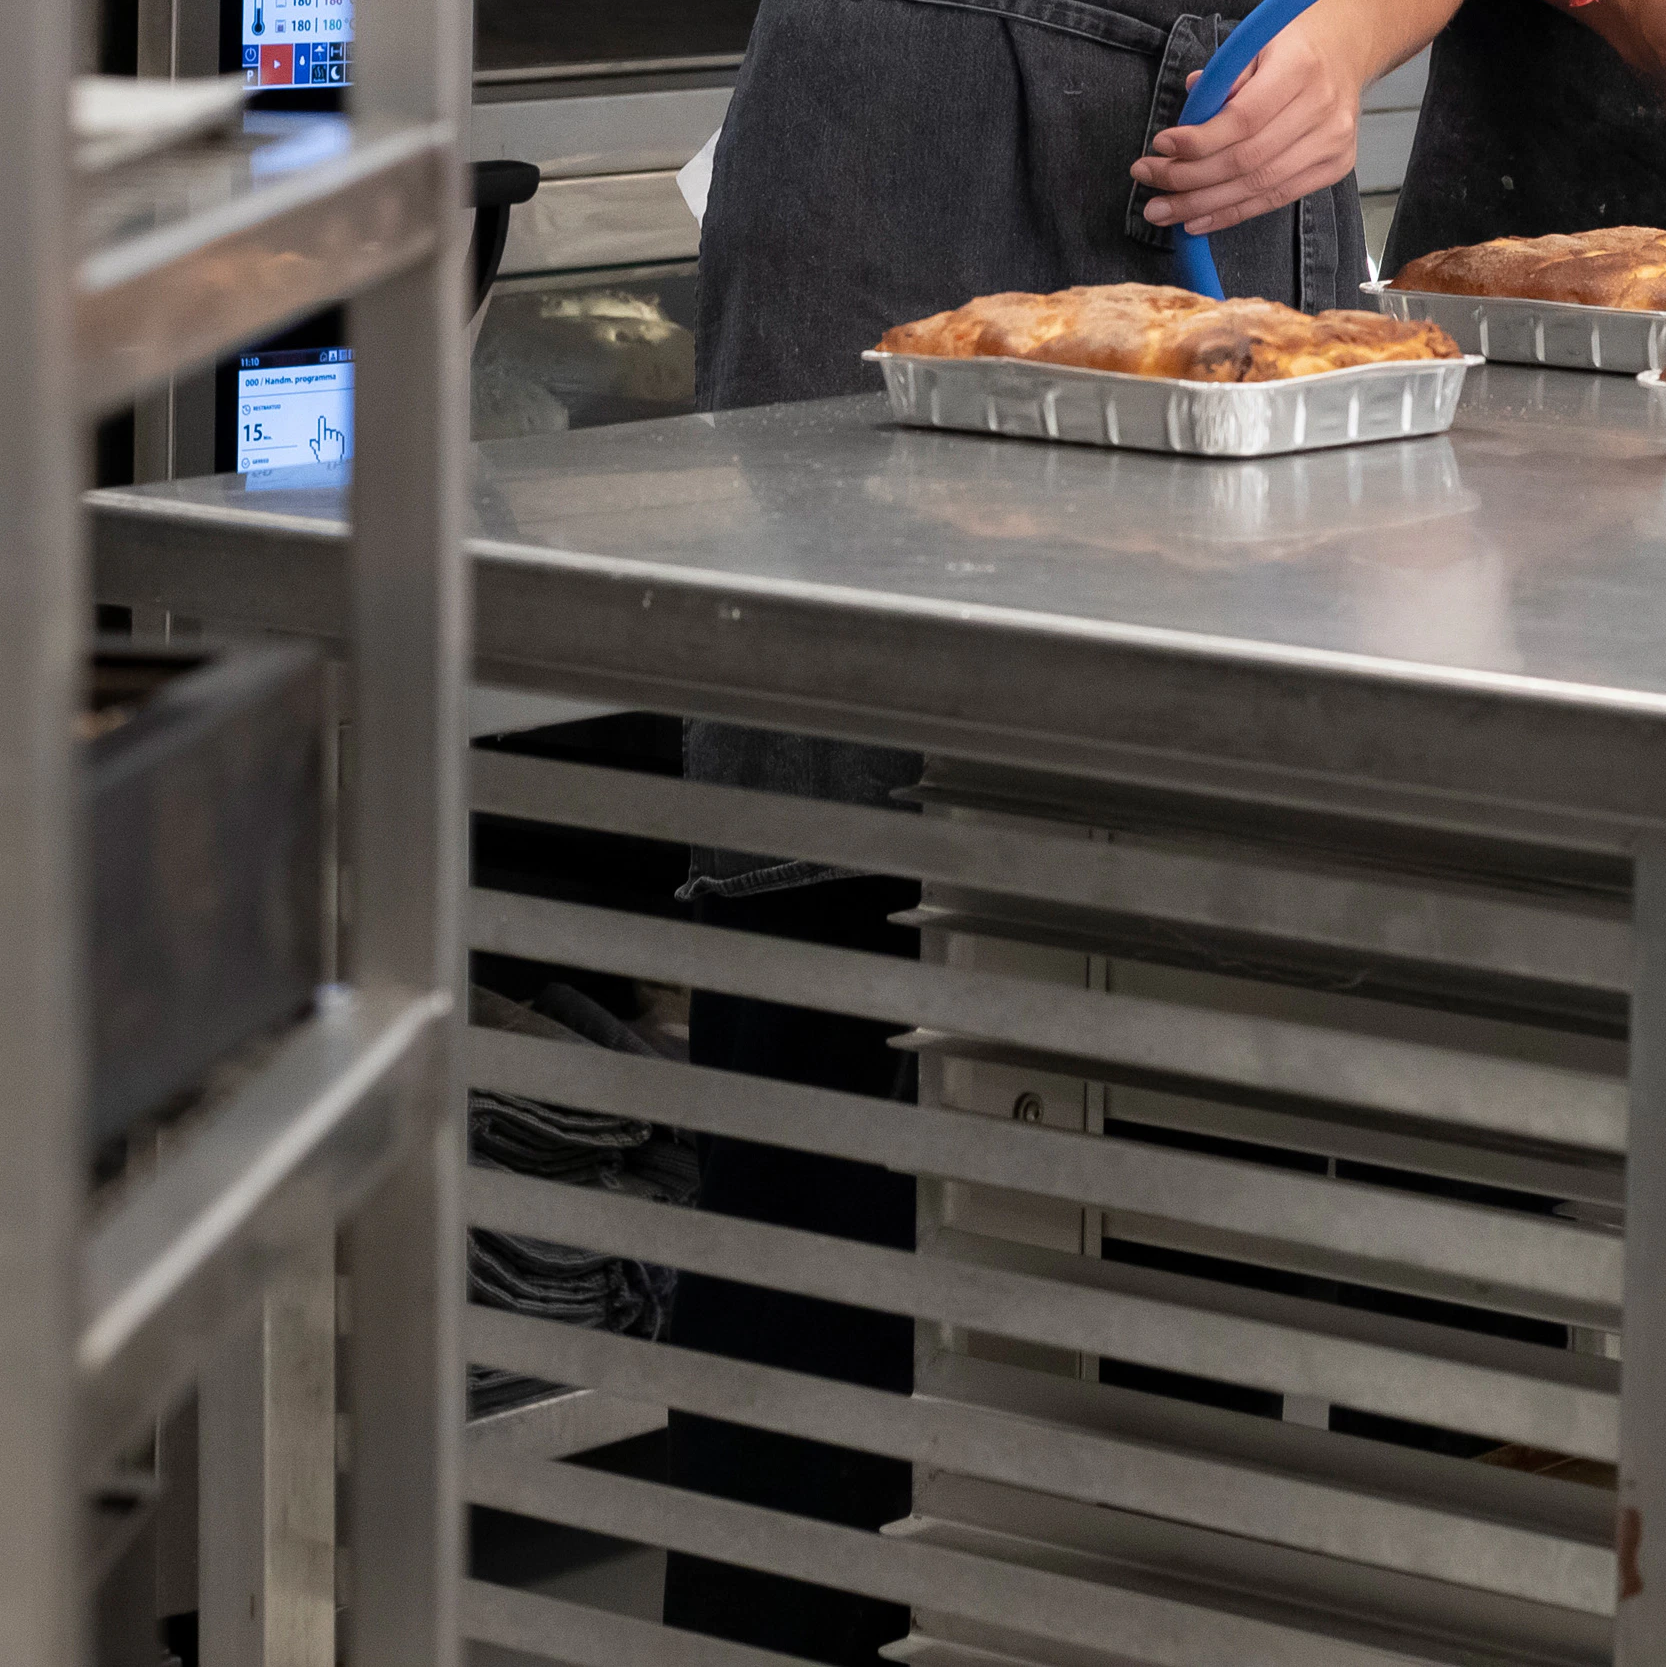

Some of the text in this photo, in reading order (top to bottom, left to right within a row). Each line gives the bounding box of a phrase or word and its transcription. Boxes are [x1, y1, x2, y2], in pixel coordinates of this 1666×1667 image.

[291, 19, 311, 32] 180
[323, 19, 342, 31] 180
[241, 357, 260, 367] 11:10
[245, 378, 259, 387] 000
[264, 376, 294, 385] Handm.
[295, 374, 336, 385] programma
[243, 423, 263, 442] 15
